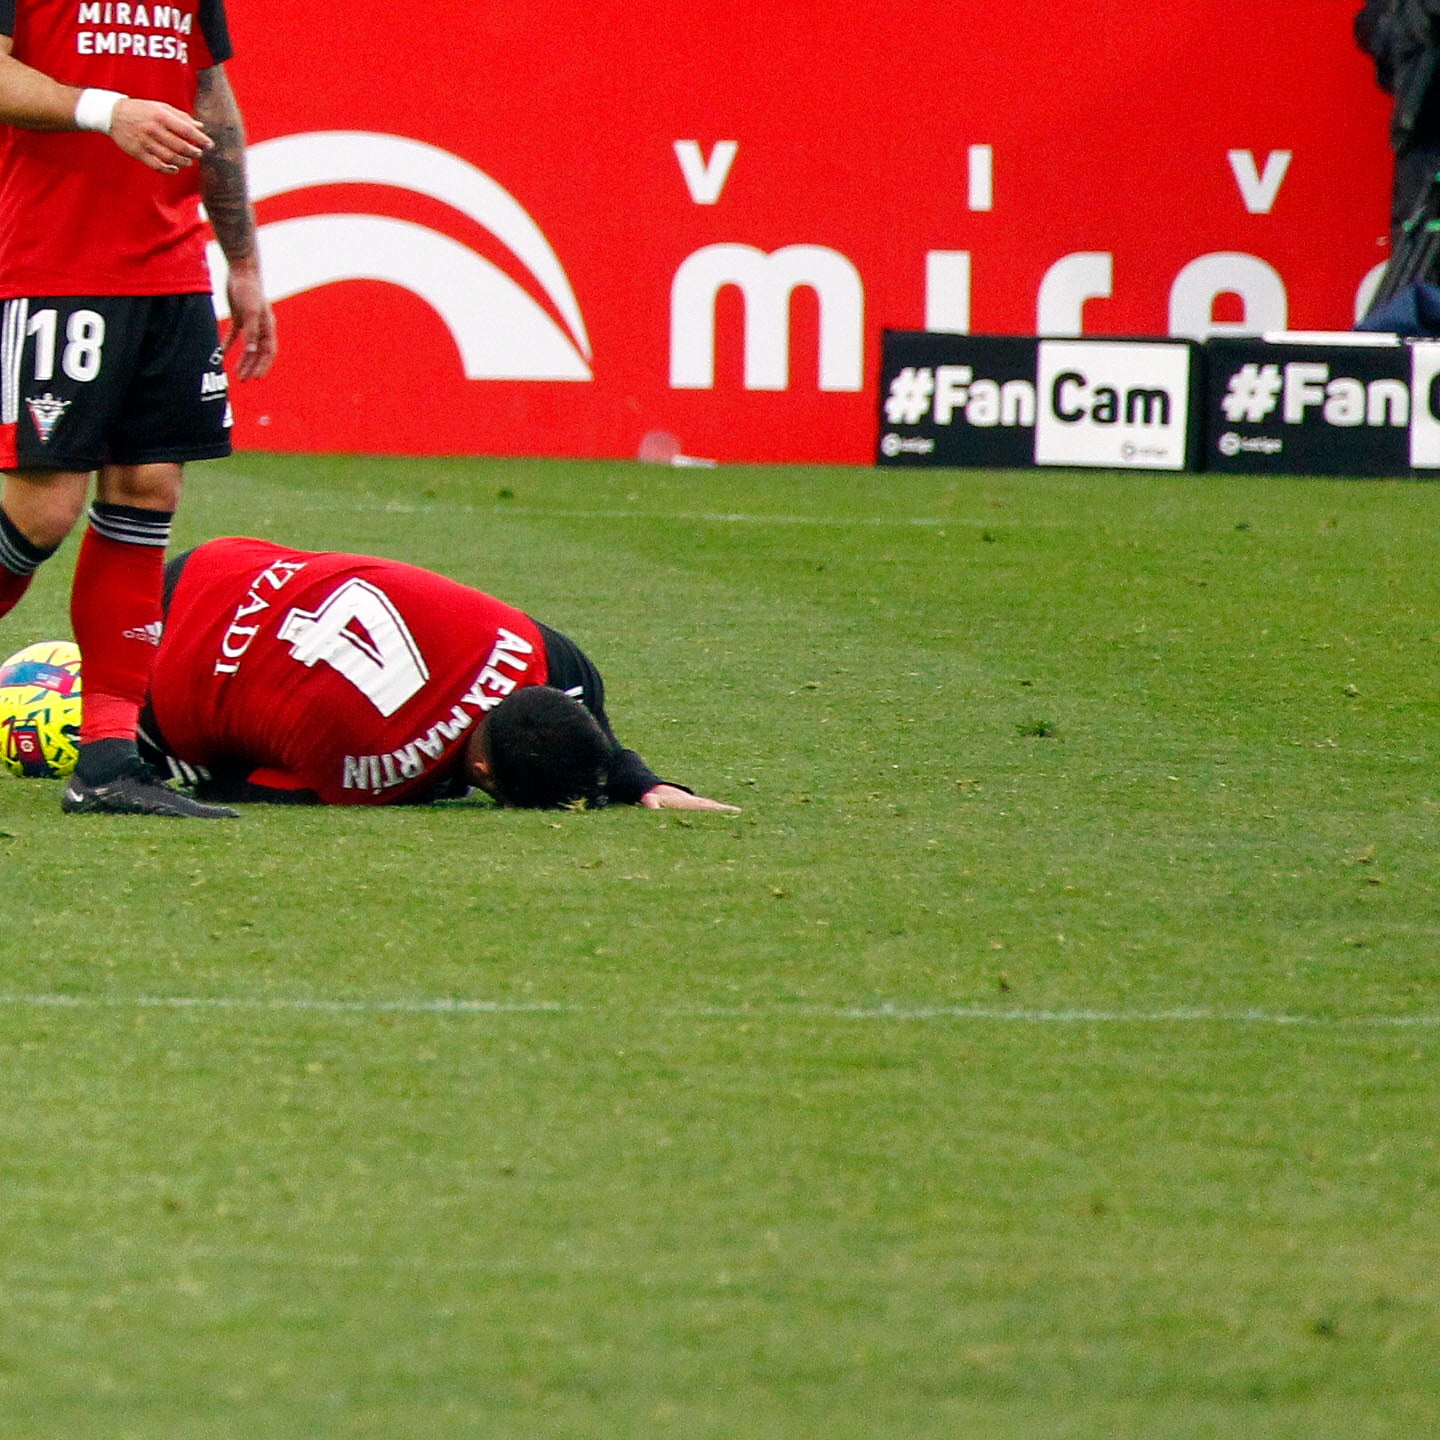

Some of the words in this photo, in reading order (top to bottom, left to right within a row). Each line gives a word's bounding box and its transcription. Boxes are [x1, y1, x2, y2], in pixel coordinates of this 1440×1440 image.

[27, 309, 106, 382] 18
[214, 559, 307, 677] IZADI
[277, 576, 430, 718] 4
[461, 627, 533, 712] ALEX
